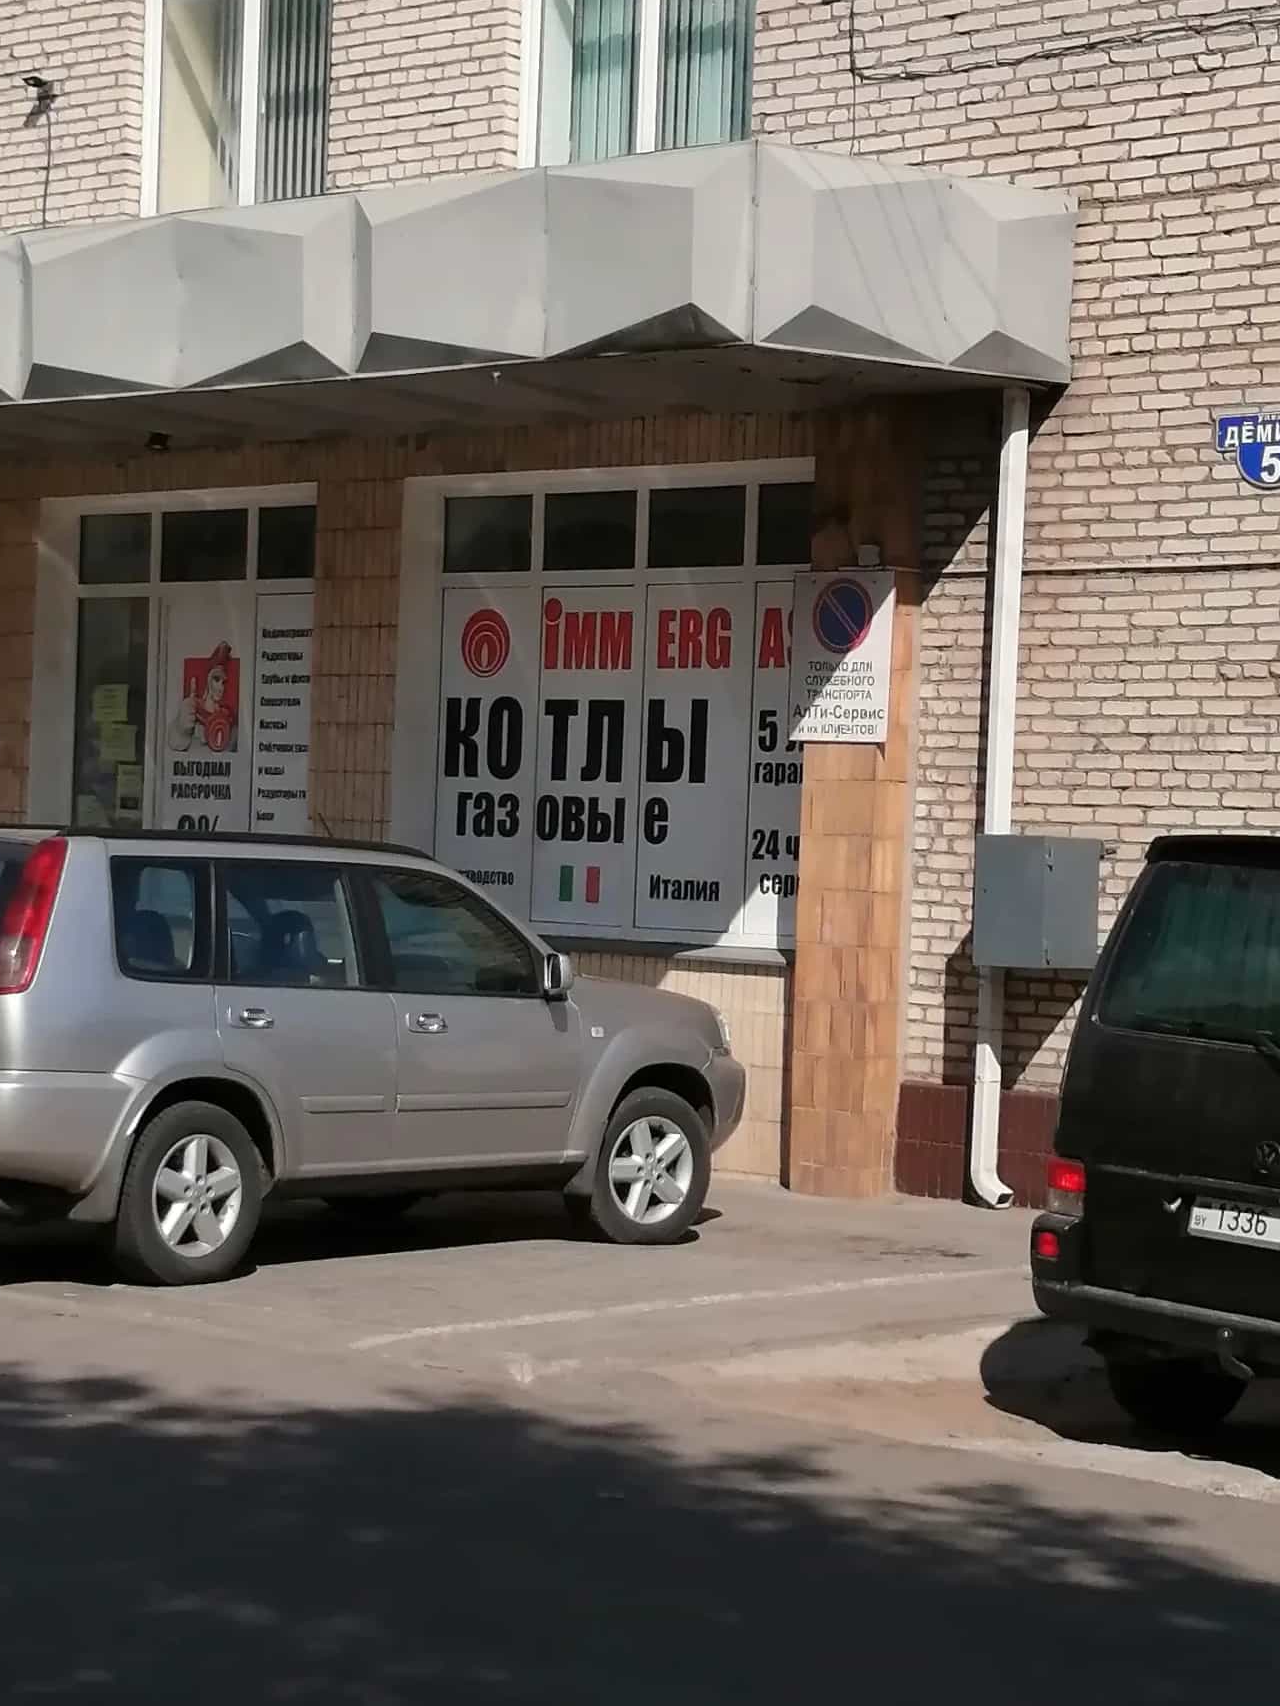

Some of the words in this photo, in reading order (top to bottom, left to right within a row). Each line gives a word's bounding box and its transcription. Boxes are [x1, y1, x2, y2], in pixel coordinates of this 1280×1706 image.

[808, 660, 849, 673] ТОЛЬКО
[851, 660, 873, 673] ДЛЯ
[805, 675, 875, 687] СЛУЖЕБНОГО
[806, 689, 872, 701] ТРАНСПОРТА
[793, 704, 886, 722] АлТи-Сервис
[758, 709, 779, 753] 5
[173, 760, 232, 778] ВЫГОДНАЯ
[170, 782, 232, 801] РАССРОЧКА
[751, 828, 780, 861] 24
[648, 872, 721, 903] Италия
